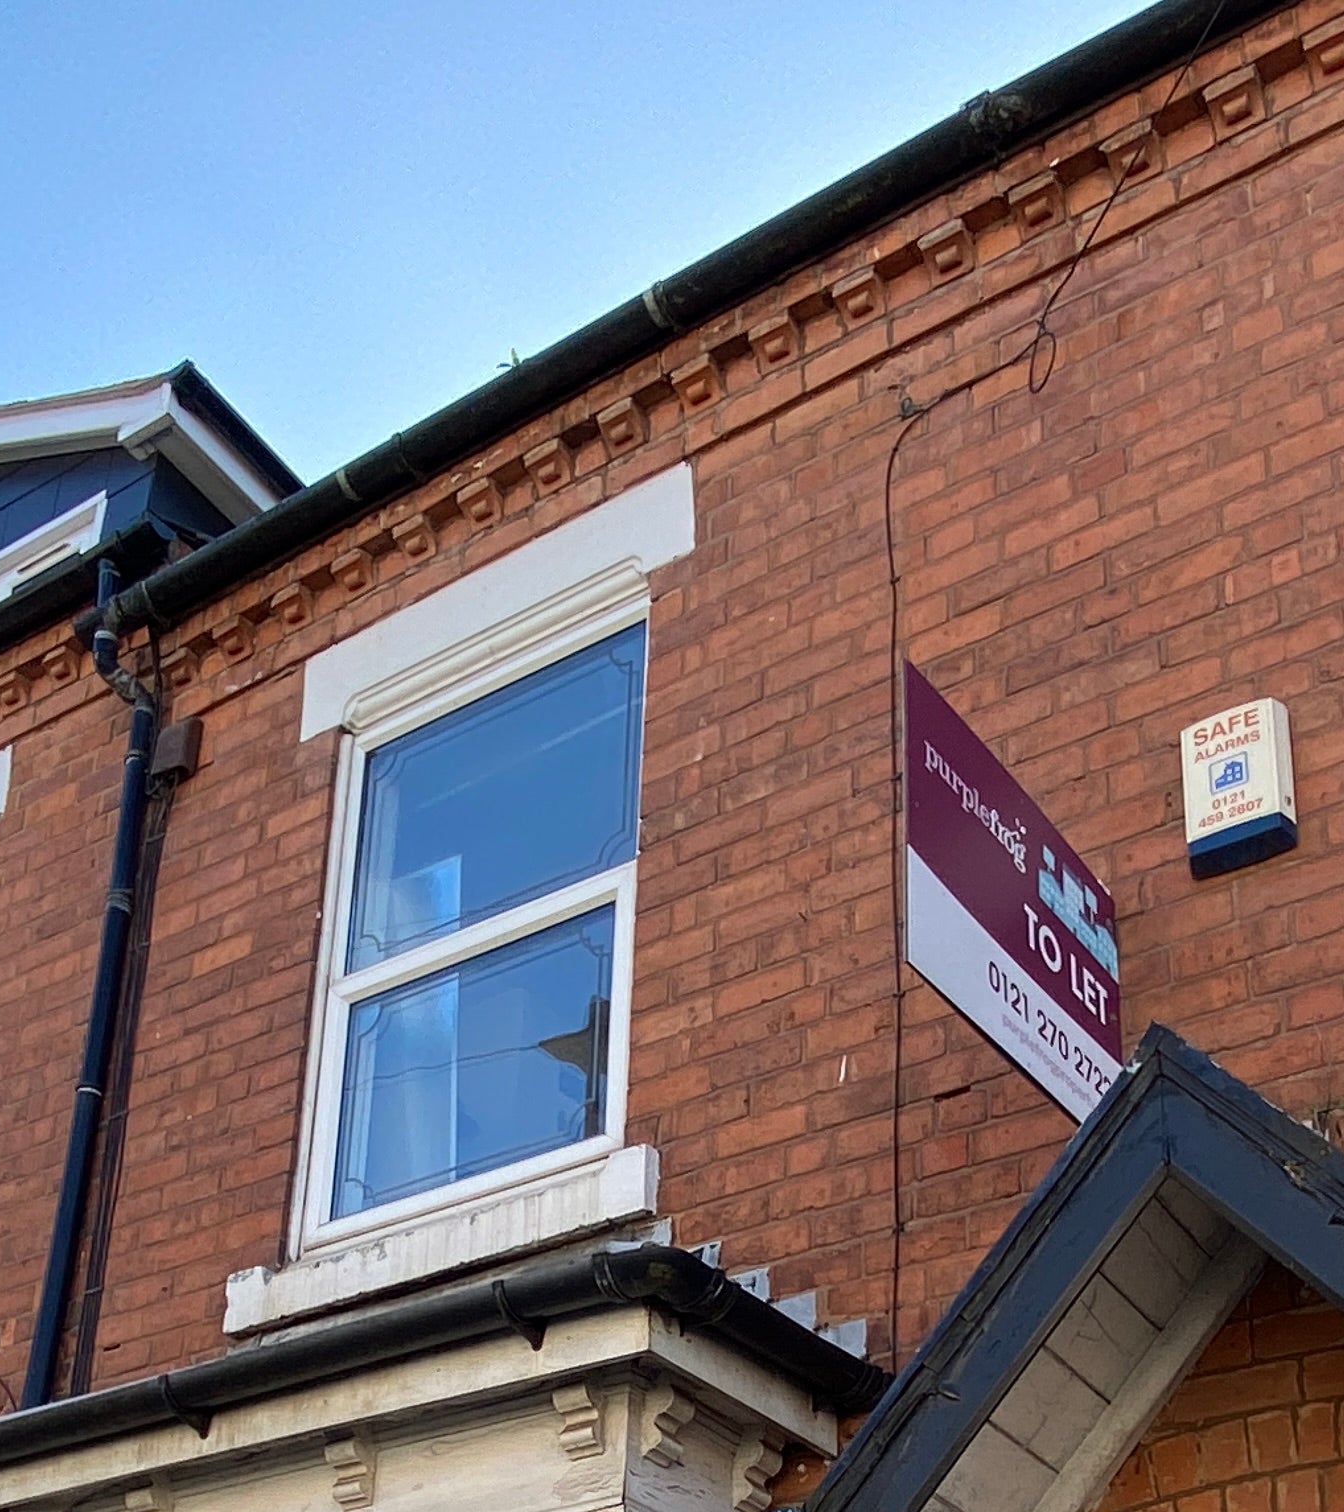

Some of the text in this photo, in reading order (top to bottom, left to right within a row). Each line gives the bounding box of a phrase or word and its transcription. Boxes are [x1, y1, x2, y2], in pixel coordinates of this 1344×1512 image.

[1193, 707, 1260, 747] SAFE
[1194, 729, 1261, 764] ALARMS
[923, 739, 1027, 875] purplefrog
[1211, 789, 1245, 810] 0121
[1023, 903, 1109, 1026] TO LET
[988, 960, 1030, 1024] 0121
[1036, 1008, 1069, 1061] 270
